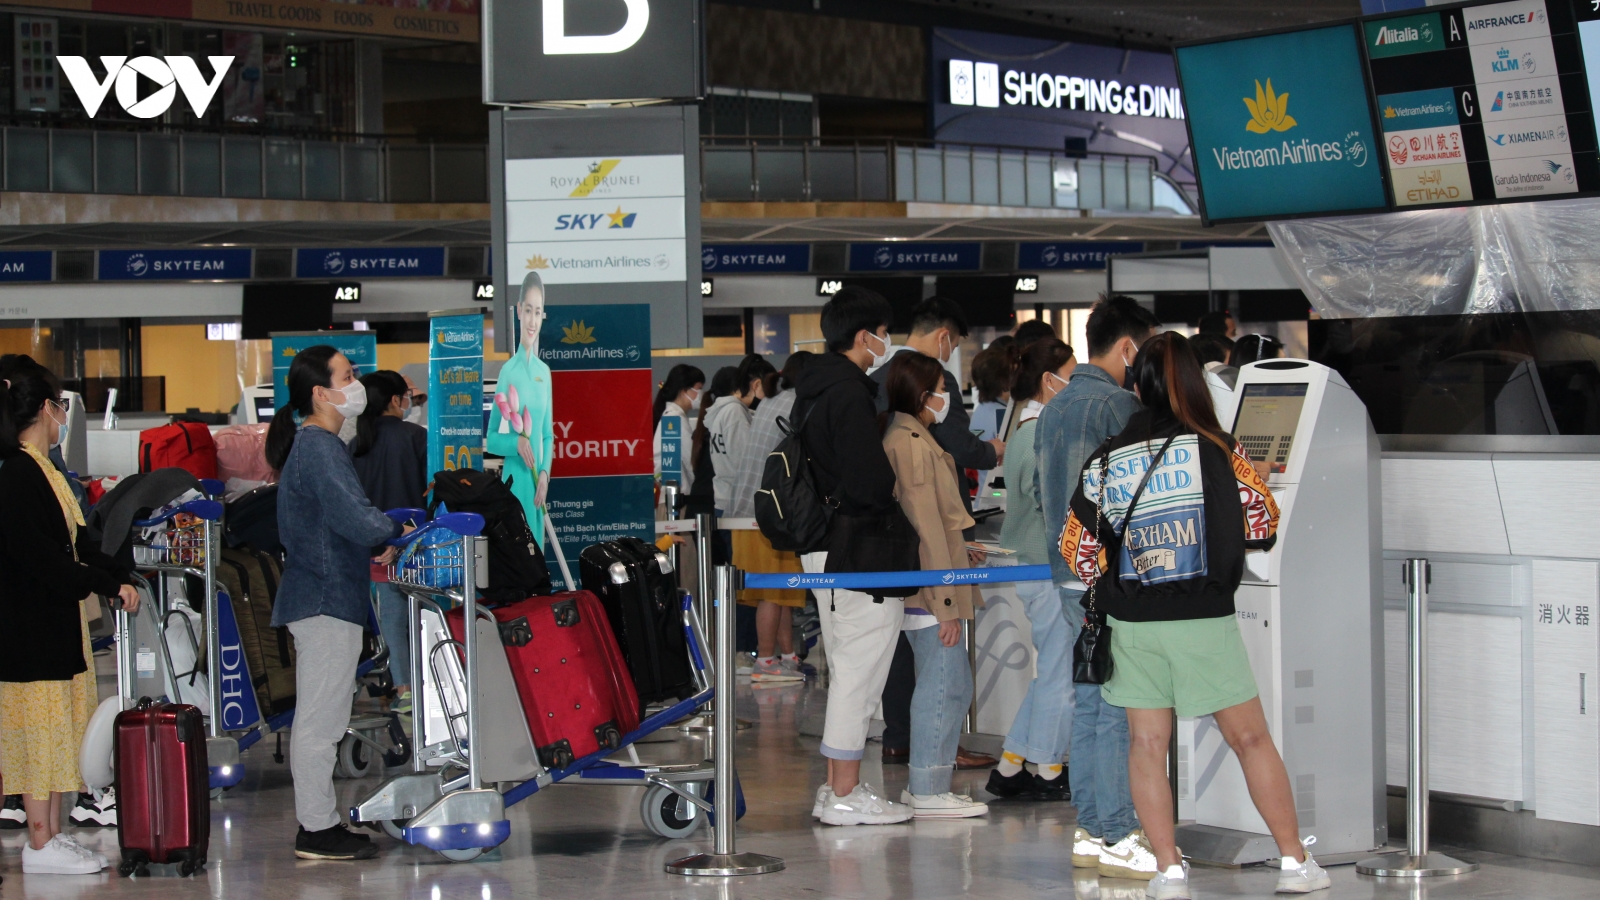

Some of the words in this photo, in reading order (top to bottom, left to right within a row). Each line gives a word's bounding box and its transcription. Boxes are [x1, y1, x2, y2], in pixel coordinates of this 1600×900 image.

[228, 2, 276, 19] TRAVEL
[279, 5, 321, 22] GOODS
[334, 10, 374, 26] FOODS
[394, 16, 460, 34] COSMETICS
[1450, 15, 1461, 41] A
[1375, 26, 1418, 45] Alitalia
[1492, 59, 1519, 72] KLM
[1004, 70, 1185, 120] SHOPPING&DINI
[1462, 91, 1473, 117] C
[1213, 147, 1279, 170] Vietnam
[1282, 138, 1342, 165] Airlines
[551, 177, 588, 189] ROYAL
[593, 175, 640, 187] BRUNEI
[1495, 175, 1518, 185] Garuda
[1407, 186, 1459, 201] ETIHAD
[555, 214, 604, 230] SKY
[350, 258, 419, 268] SKYTEAM
[550, 258, 603, 269] Vietnam
[604, 256, 651, 268] Airlines
[722, 255, 786, 264] SKYTEAM
[897, 254, 958, 263] SKYTEAM
[154, 261, 224, 271] SKYTEAM
[821, 281, 842, 294] A24
[1016, 278, 1037, 291] A25
[335, 287, 359, 300] A21
[477, 285, 494, 298] A2
[582, 348, 623, 359] Airlines
[565, 510, 585, 518] Class
[1539, 604, 1590, 626] 消火器
[221, 642, 243, 727] DHC
